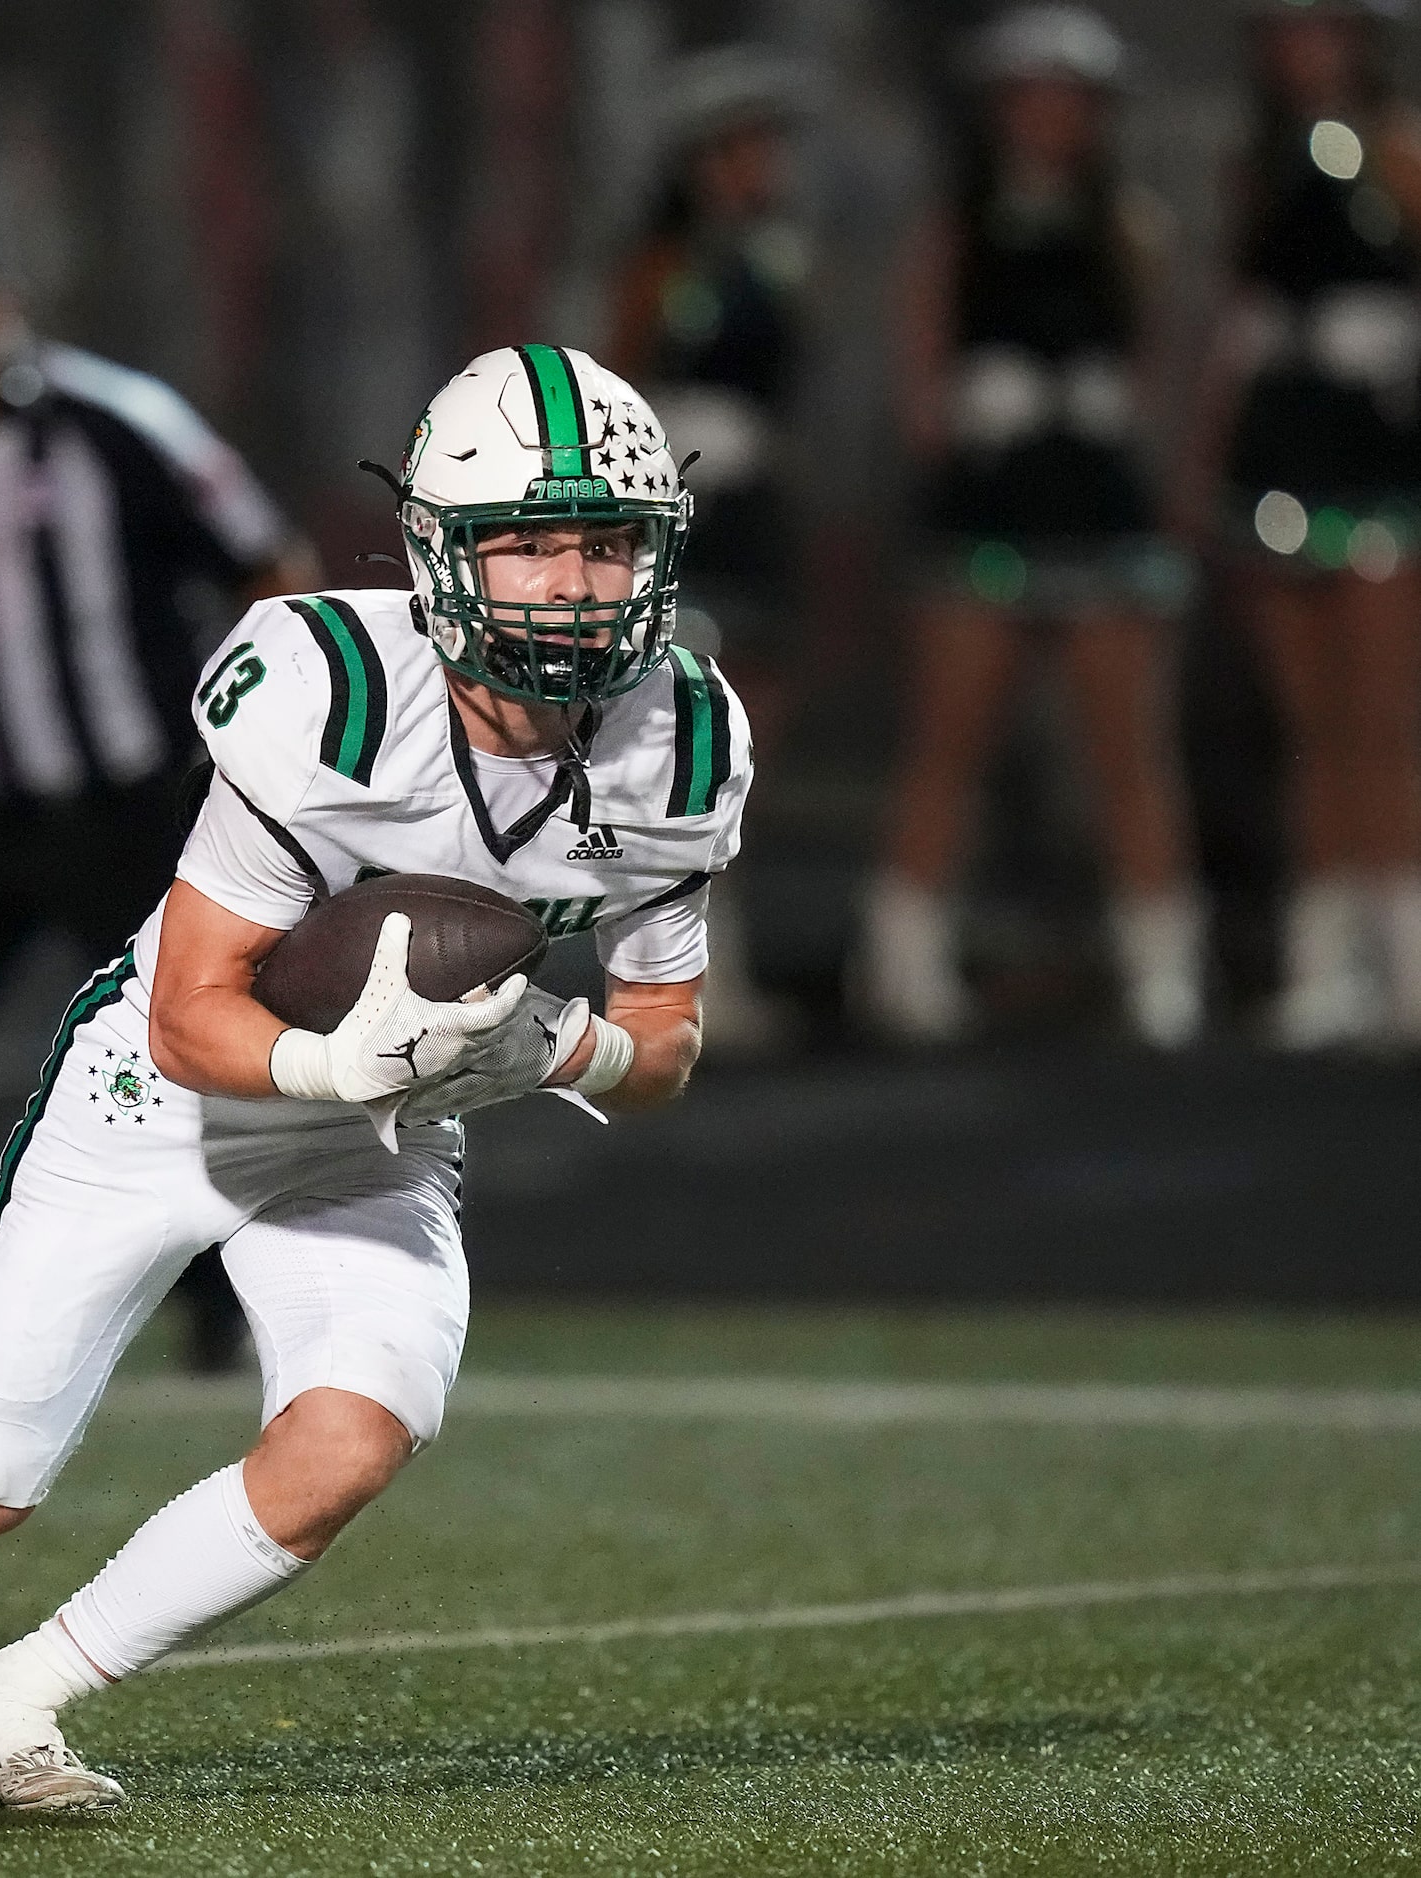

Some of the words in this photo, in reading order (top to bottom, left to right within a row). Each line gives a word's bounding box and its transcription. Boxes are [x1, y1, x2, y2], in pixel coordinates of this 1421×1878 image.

[530, 478, 618, 499] 76092
[198, 641, 267, 729] 13
[567, 848, 624, 860] adidas
